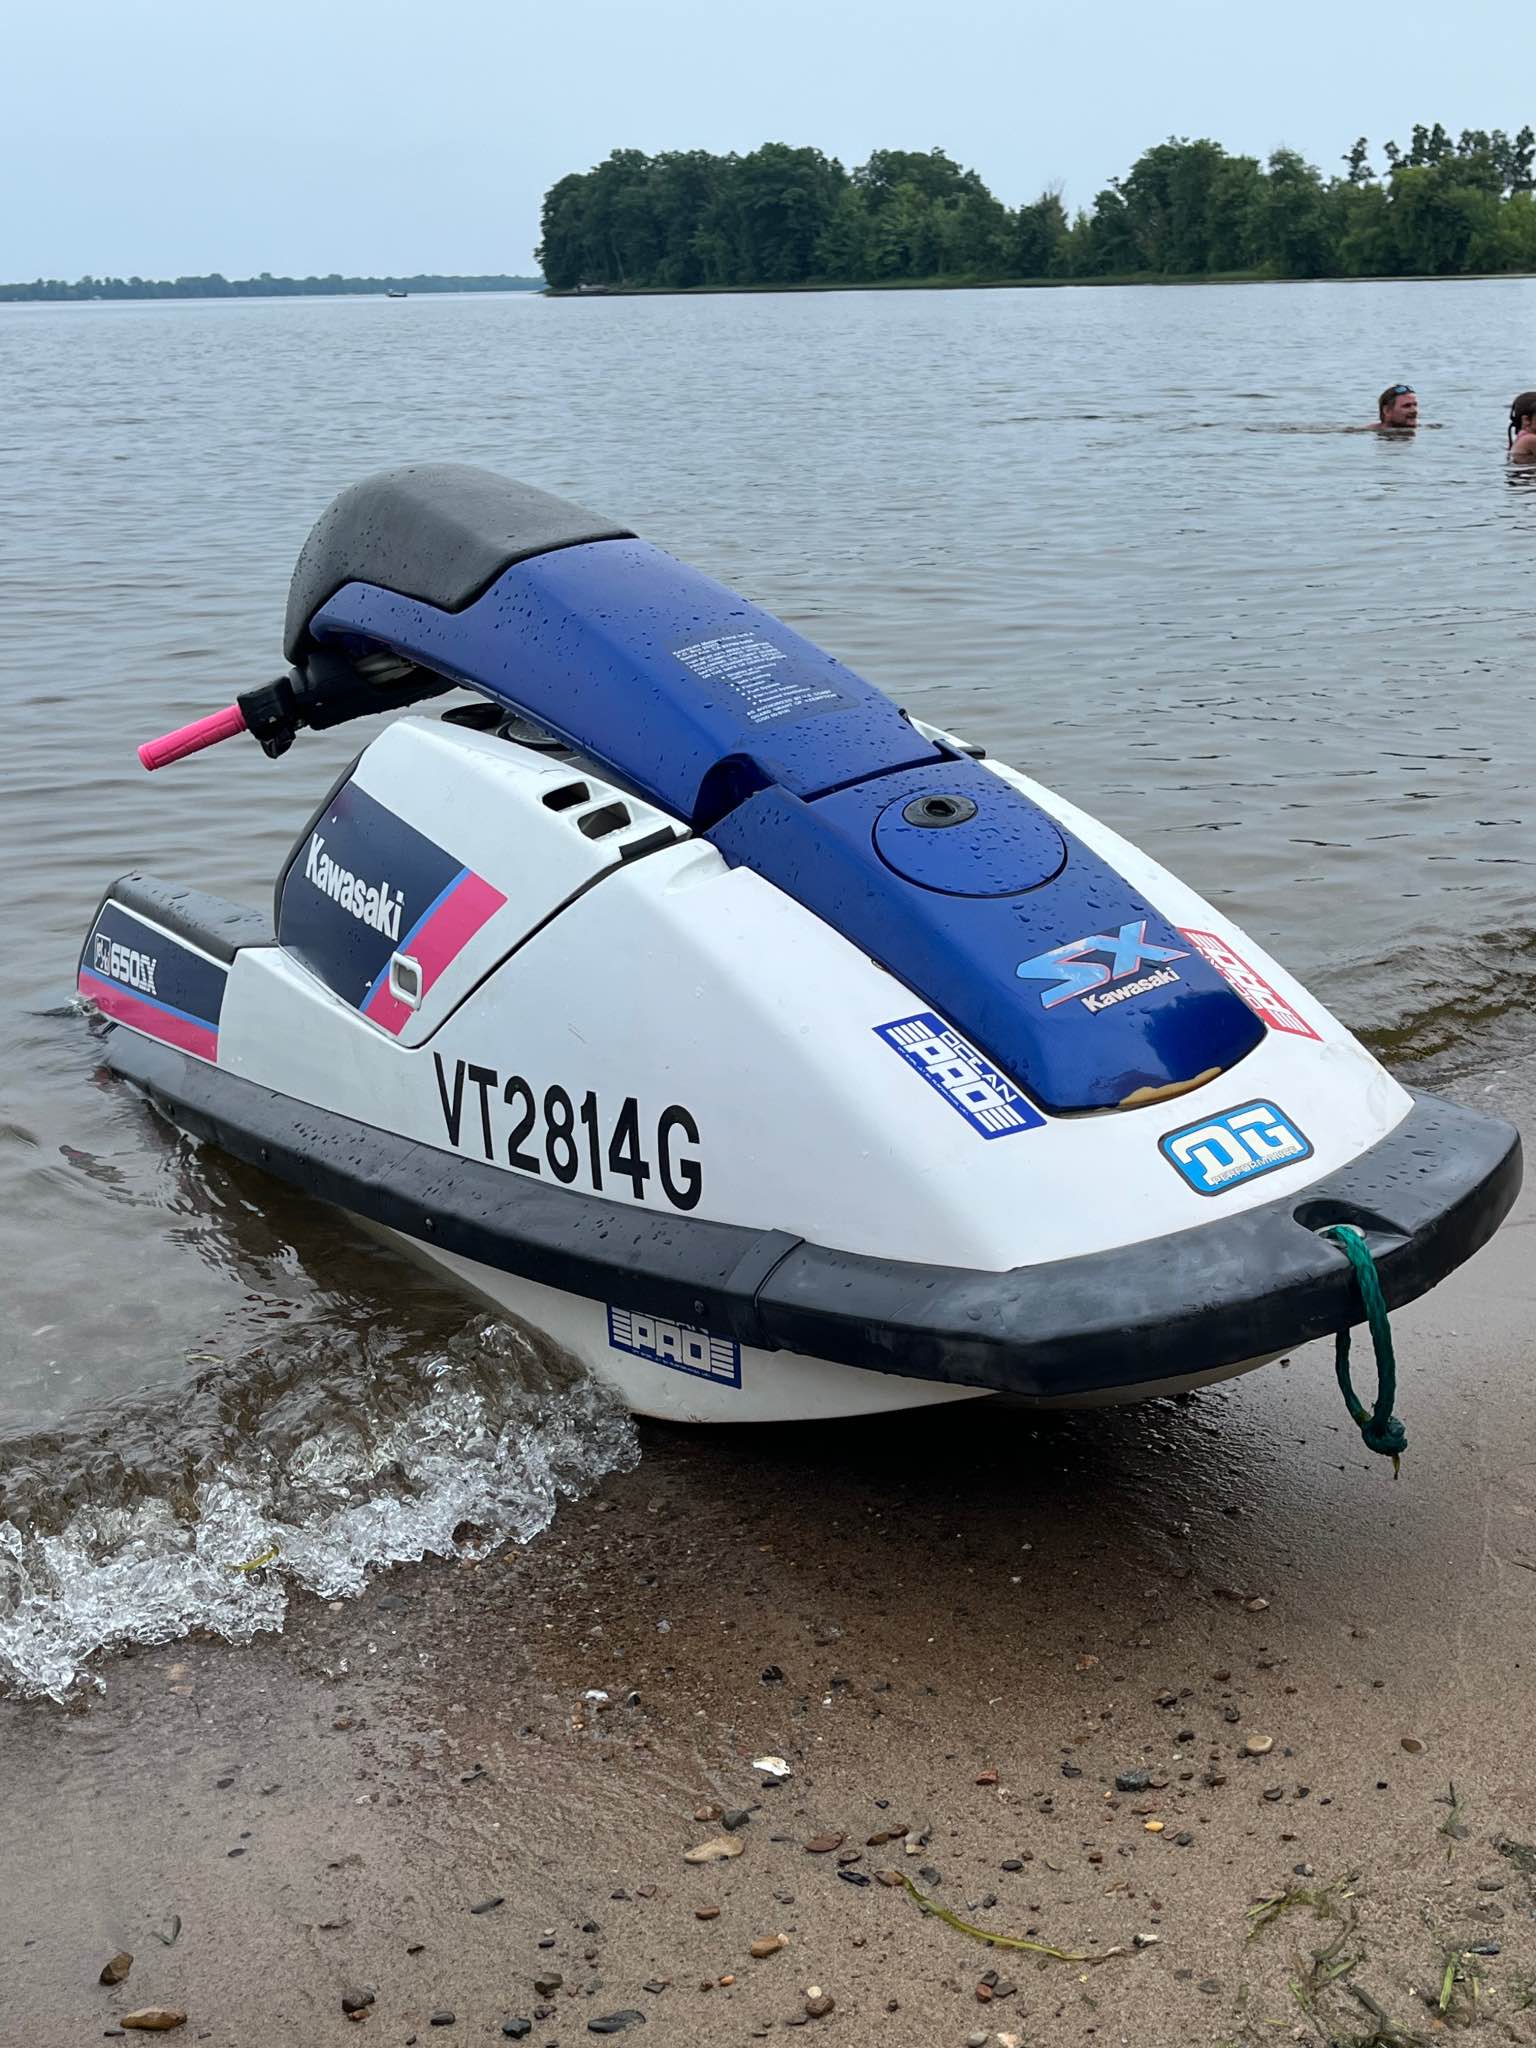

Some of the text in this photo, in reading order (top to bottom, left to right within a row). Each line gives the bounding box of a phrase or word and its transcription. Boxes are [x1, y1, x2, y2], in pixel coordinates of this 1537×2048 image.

[305, 832, 404, 942] Kawasaki
[111, 942, 157, 995] 650SX
[1016, 920, 1191, 1009] SX
[1081, 967, 1180, 1013] Kawasaki
[902, 1036, 1007, 1113] PRO
[938, 1030, 1018, 1104] OCEAN
[433, 1051, 702, 1211] VT2814G
[1171, 1107, 1304, 1186] DG
[631, 1312, 711, 1372] PRO
